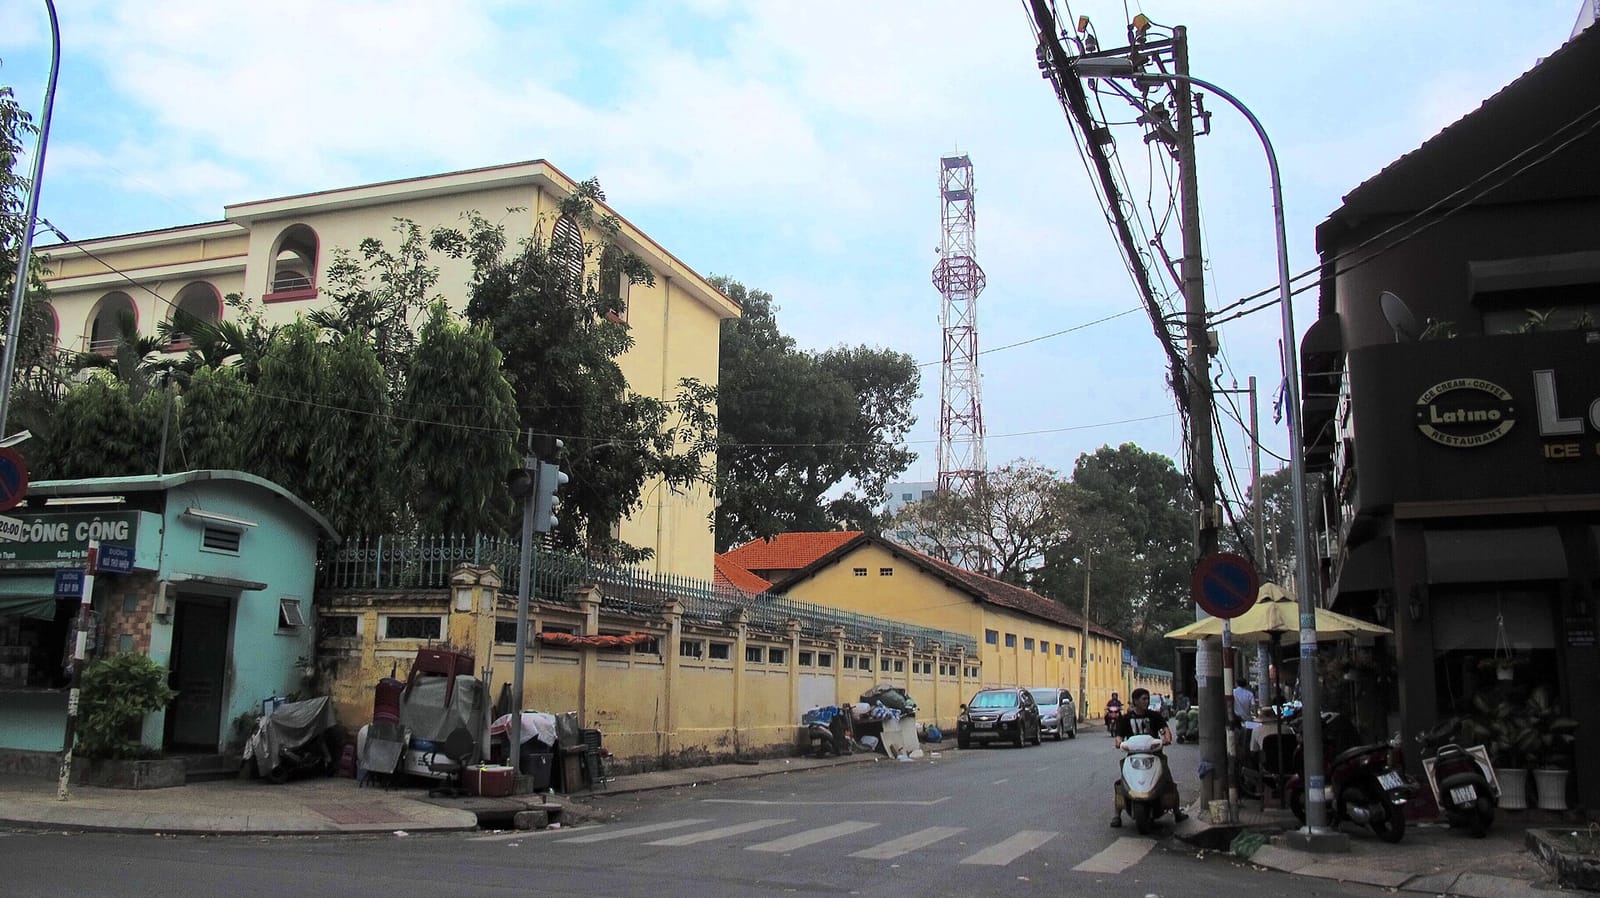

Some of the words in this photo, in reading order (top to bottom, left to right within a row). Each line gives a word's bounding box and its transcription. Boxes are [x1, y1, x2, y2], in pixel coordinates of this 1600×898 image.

[1422, 390, 1436, 403] ICE
[1435, 380, 1466, 393] CREAM
[1473, 380, 1506, 398] COFFEE
[1430, 404, 1501, 423] Latino
[1431, 430, 1502, 445] RESTAURANT
[1544, 443, 1581, 458] ICE
[21, 519, 69, 543] CÔNG
